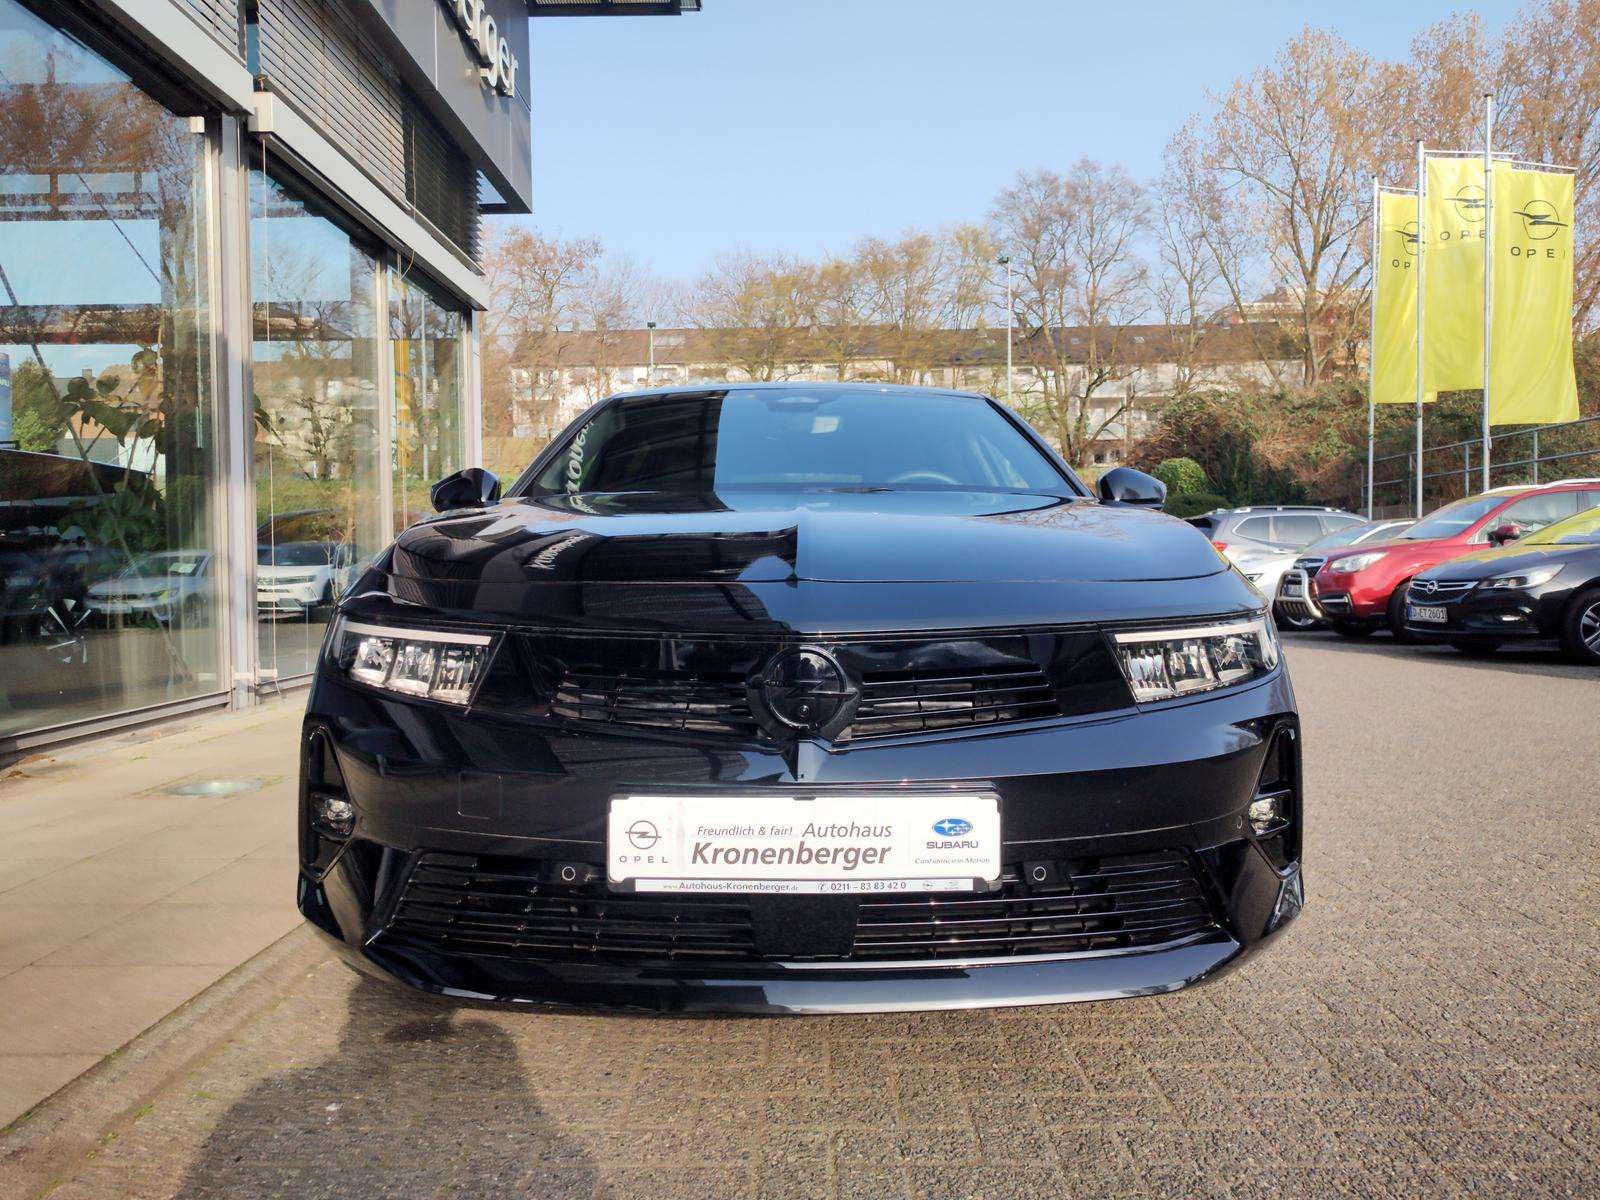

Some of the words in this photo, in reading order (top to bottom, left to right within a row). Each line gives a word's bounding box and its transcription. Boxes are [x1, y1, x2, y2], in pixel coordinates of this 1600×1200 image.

[1439, 229, 1486, 241] OPE
[1391, 258, 1411, 269] OP
[697, 825, 755, 837] Freundlich
[758, 826, 767, 836] &
[770, 825, 793, 836] fair!
[802, 821, 893, 838] Autohaus
[926, 841, 979, 849] SUBARU
[619, 855, 669, 864] OPEL
[691, 841, 893, 871] Kronenberger
[830, 883, 850, 891] 0211
[887, 882, 898, 890] 42
